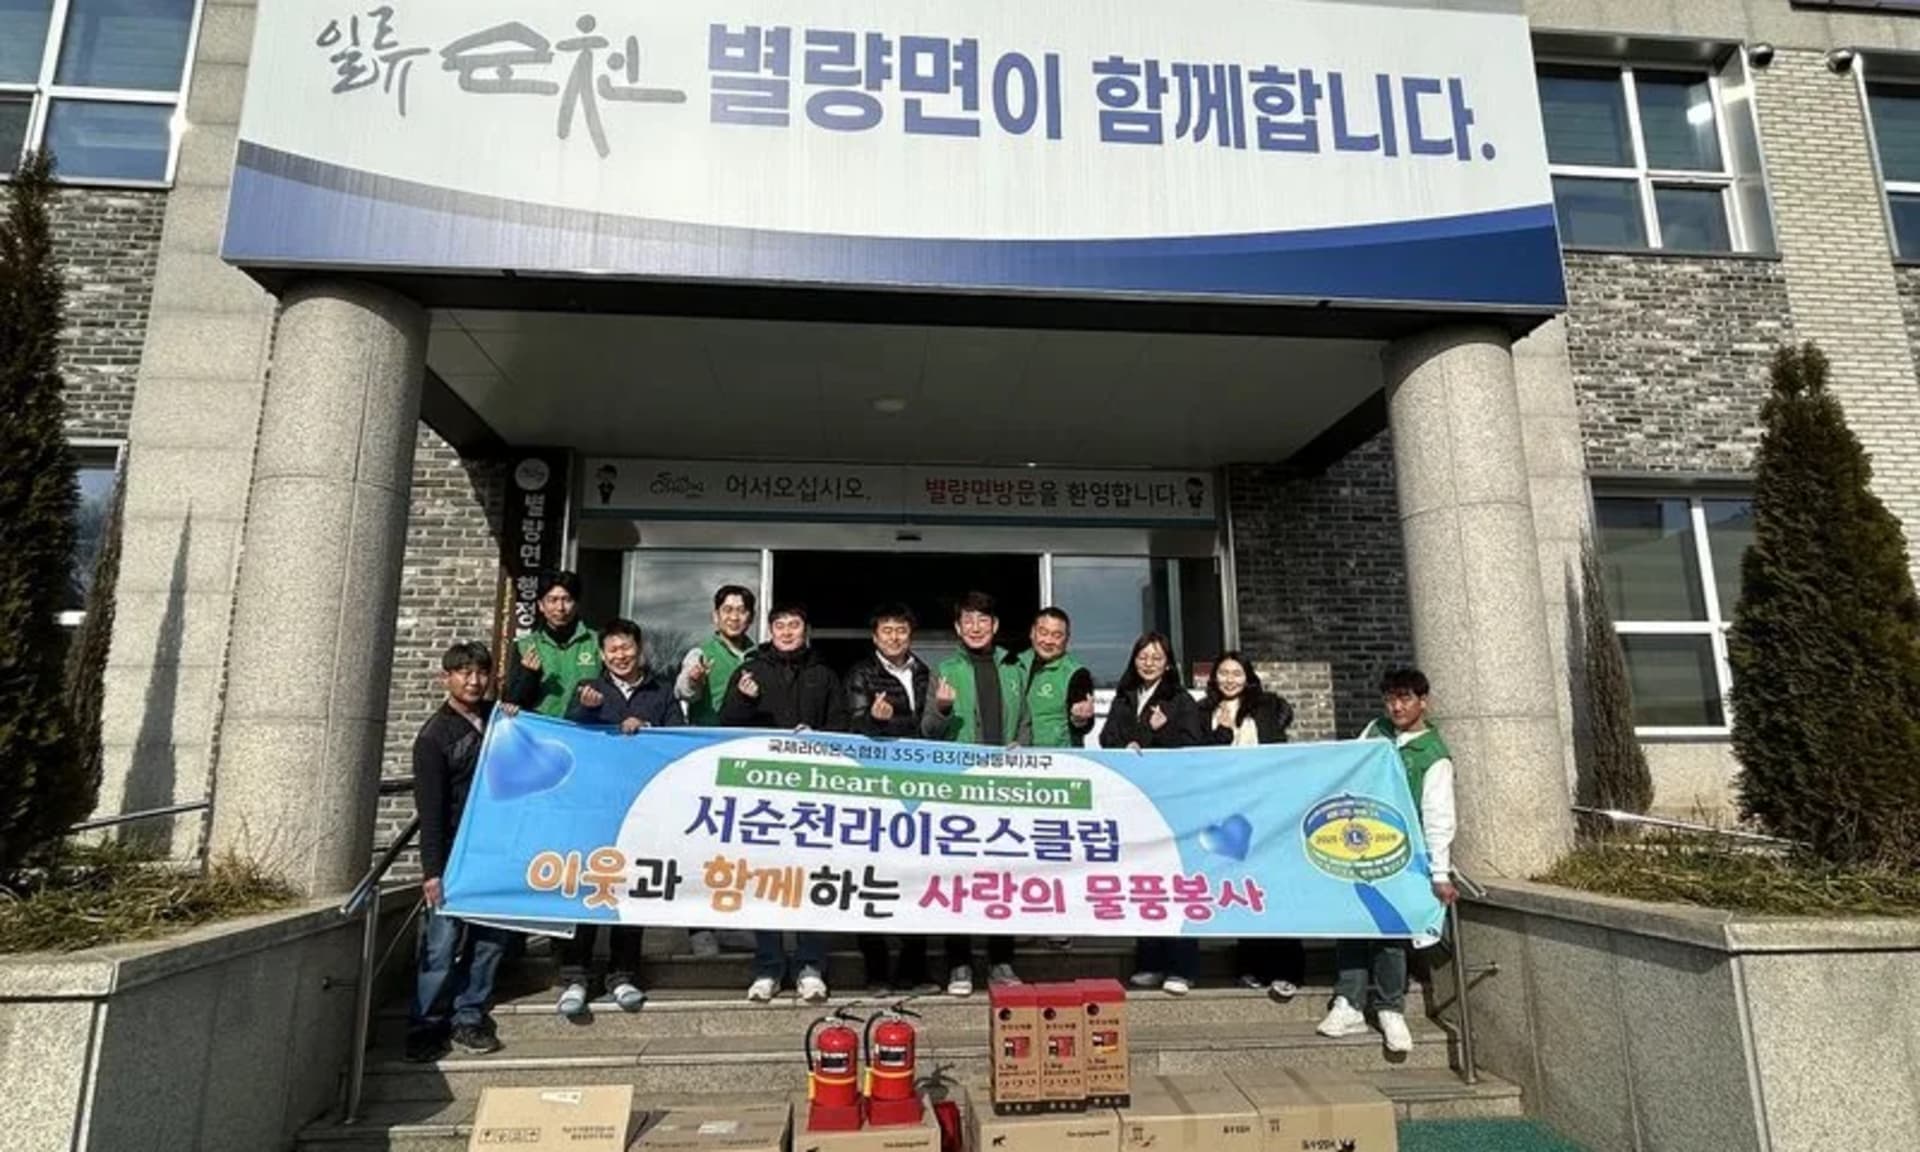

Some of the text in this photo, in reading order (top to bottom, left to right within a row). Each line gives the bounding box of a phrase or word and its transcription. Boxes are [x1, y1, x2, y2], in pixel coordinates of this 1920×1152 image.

[316, 5, 1497, 161] 일류 순천 별량면이 함께합니다.
[726, 473, 872, 502] 어서오십시오.
[925, 477, 1058, 507] 별량면방문을
[1067, 481, 1184, 508] 환영합니다.
[519, 493, 546, 568] 별량면
[768, 738, 887, 761] 국제라이온스협회
[808, 767, 893, 796] heart
[900, 781, 953, 800] one
[684, 795, 1120, 862] 서순천라이온스클럽
[529, 849, 1264, 921] 이웃과 함께하는 사랑의 물풍봉사
